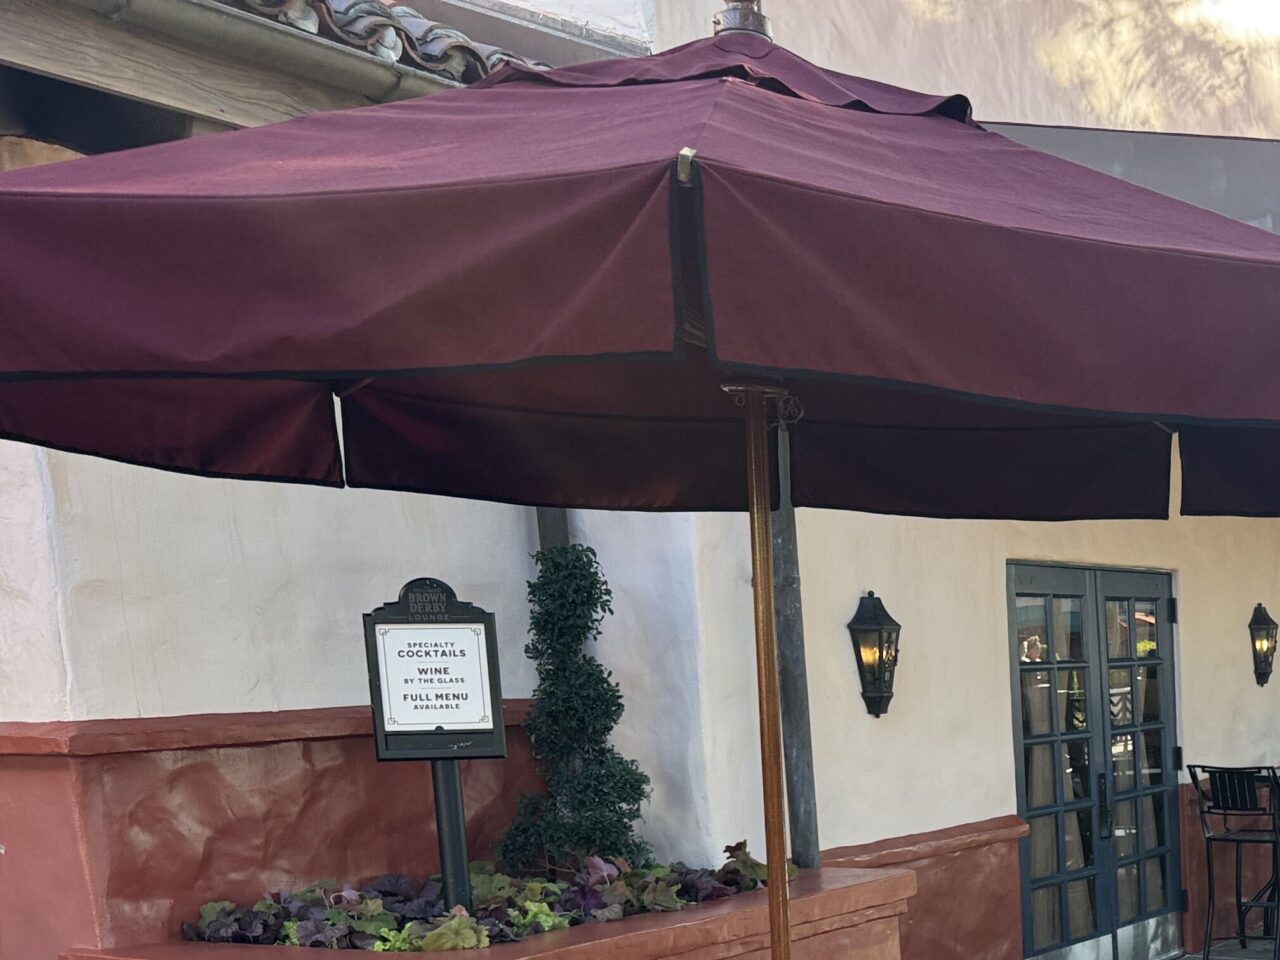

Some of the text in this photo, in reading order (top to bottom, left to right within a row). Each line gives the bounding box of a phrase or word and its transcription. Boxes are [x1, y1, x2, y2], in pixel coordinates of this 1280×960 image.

[408, 592, 447, 602] BROWN
[409, 602, 447, 613] DERBY
[397, 649, 466, 658] COCKTAILS
[417, 667, 450, 675] WINE
[403, 692, 468, 702] FULL MENU
